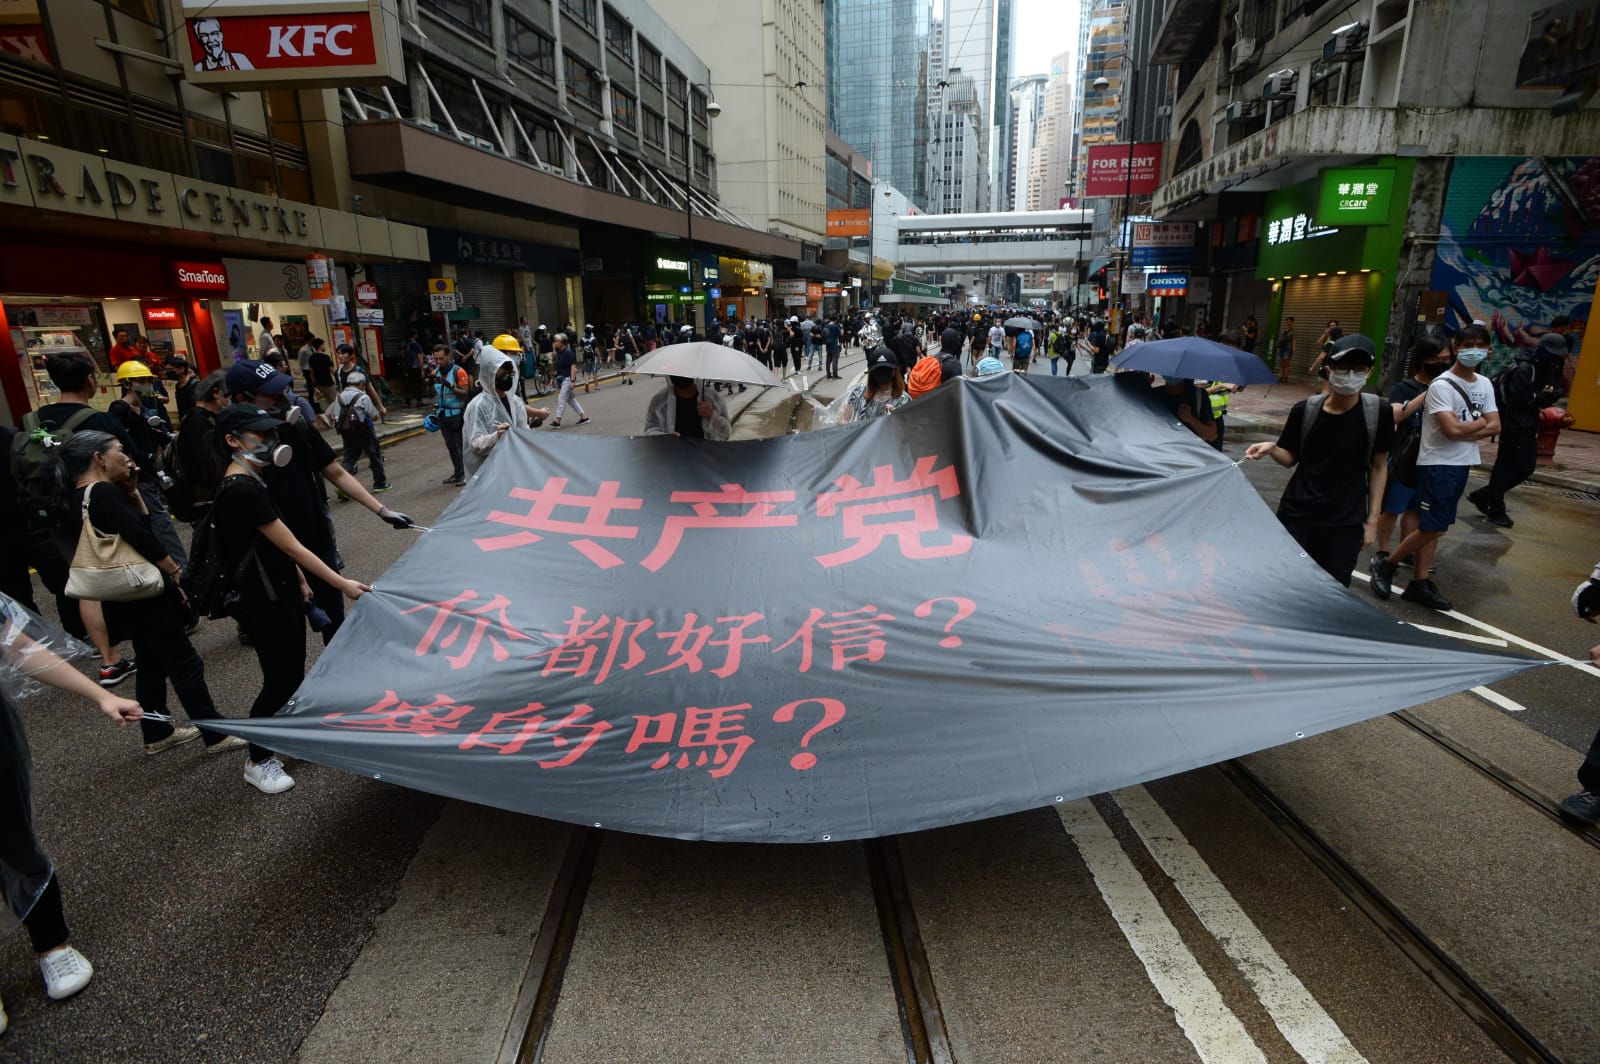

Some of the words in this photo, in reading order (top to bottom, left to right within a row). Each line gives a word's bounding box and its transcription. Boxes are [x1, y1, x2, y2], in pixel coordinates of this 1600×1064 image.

[266, 24, 353, 58] KFC
[1092, 159, 1117, 169] FOR
[1121, 157, 1155, 168] RENT
[0, 149, 165, 213] TRADE
[182, 188, 308, 237] CENTRE
[1337, 182, 1379, 196] 華潤堂
[1267, 213, 1308, 246] 華潤堂
[178, 268, 225, 284] SmarTone
[1150, 277, 1187, 285] ONKYO
[472, 455, 976, 573] 共产党
